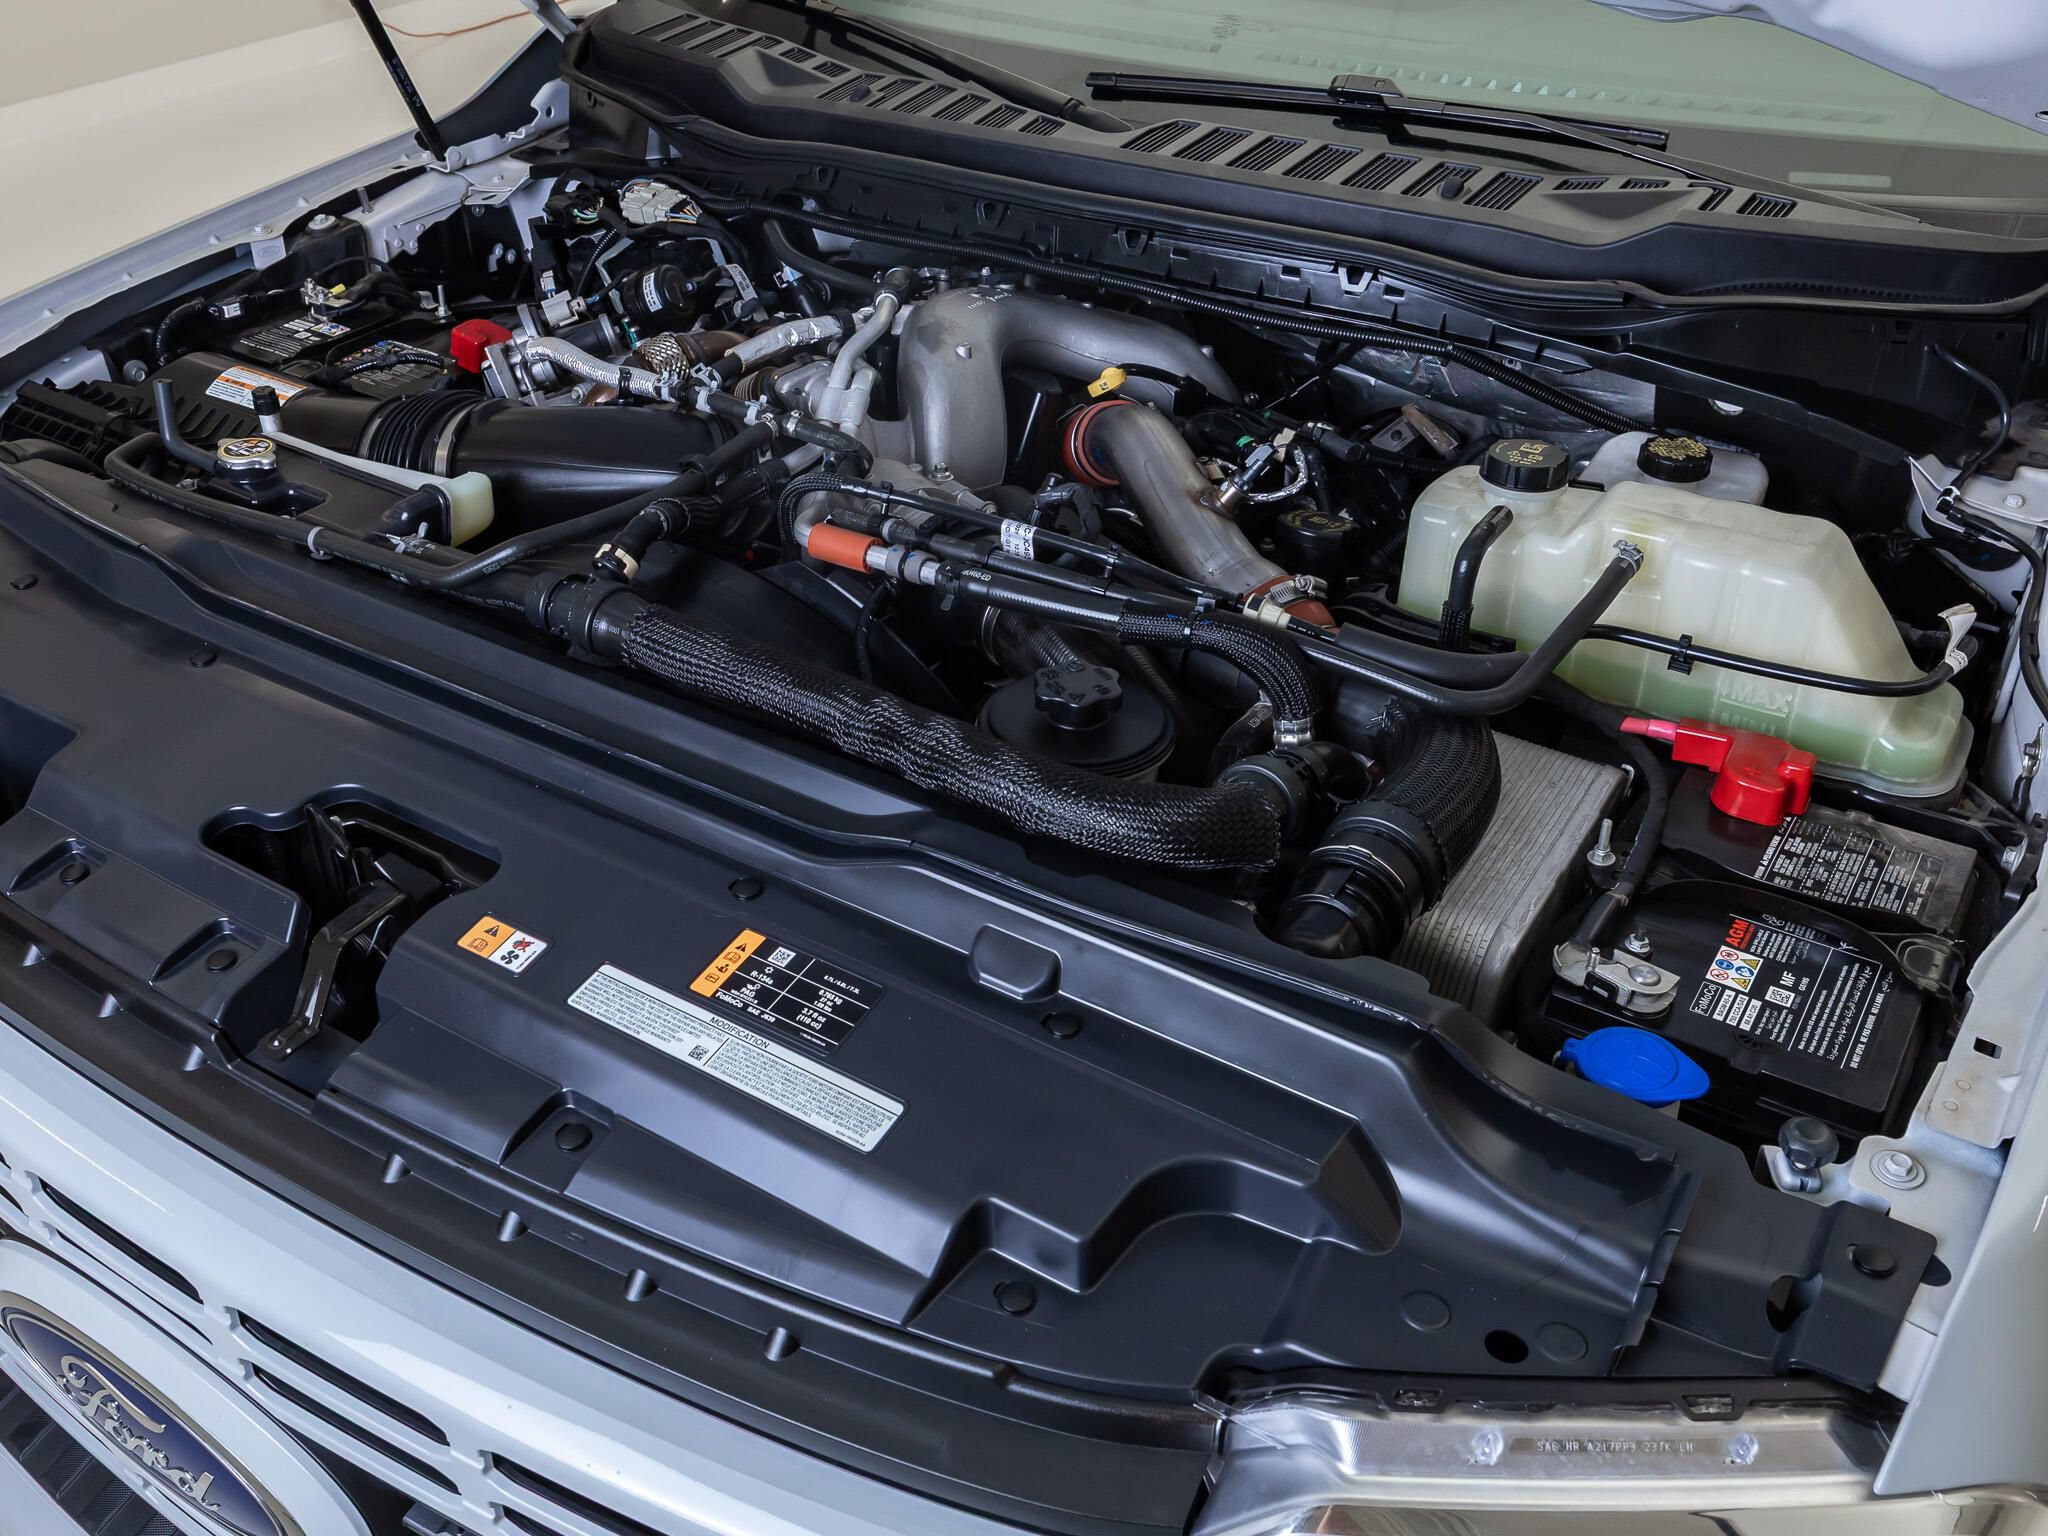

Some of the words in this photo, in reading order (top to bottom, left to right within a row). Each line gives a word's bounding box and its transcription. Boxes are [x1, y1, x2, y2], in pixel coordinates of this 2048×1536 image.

[1725, 919, 1748, 946] AGM
[749, 970, 773, 984] R-134a
[1779, 970, 1795, 987] MF
[739, 986, 755, 997] PAG
[1694, 984, 1716, 1015] FoMoCo
[715, 991, 743, 1007] FoMoCo
[746, 1006, 760, 1015] SAE
[795, 1013, 812, 1024] (110
[809, 1020, 822, 1030] cc)
[801, 1007, 813, 1015] 3.7
[816, 1015, 826, 1023] oz
[709, 1016, 770, 1048] MODIFICATION
[56, 1354, 222, 1511] Ford
[1566, 1440, 1579, 1452] HR
[1680, 1440, 1694, 1453] LH
